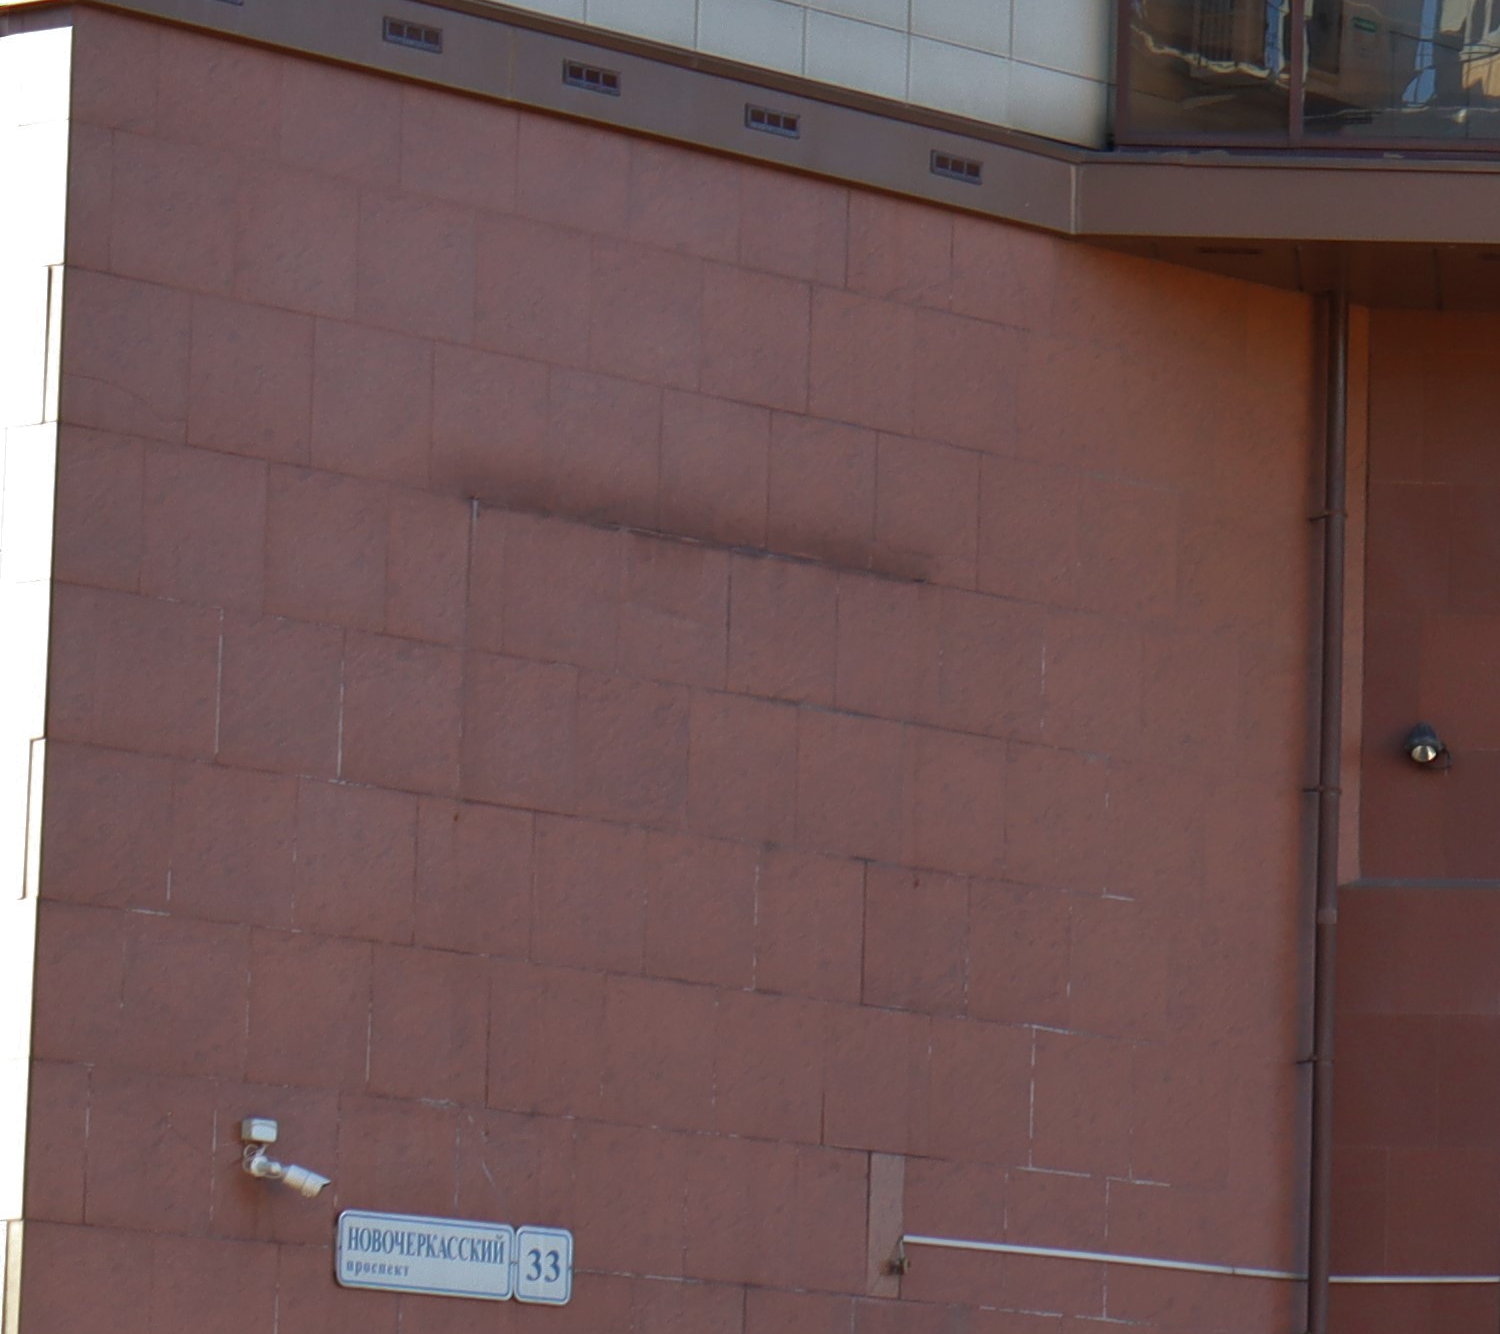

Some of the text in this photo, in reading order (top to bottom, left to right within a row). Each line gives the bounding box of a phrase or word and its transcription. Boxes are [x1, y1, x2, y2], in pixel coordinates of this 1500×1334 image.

[348, 1225, 505, 1265] НОВОЧЕРКАССКИЙ
[346, 1259, 410, 1277] проспект
[525, 1248, 561, 1283] 33
